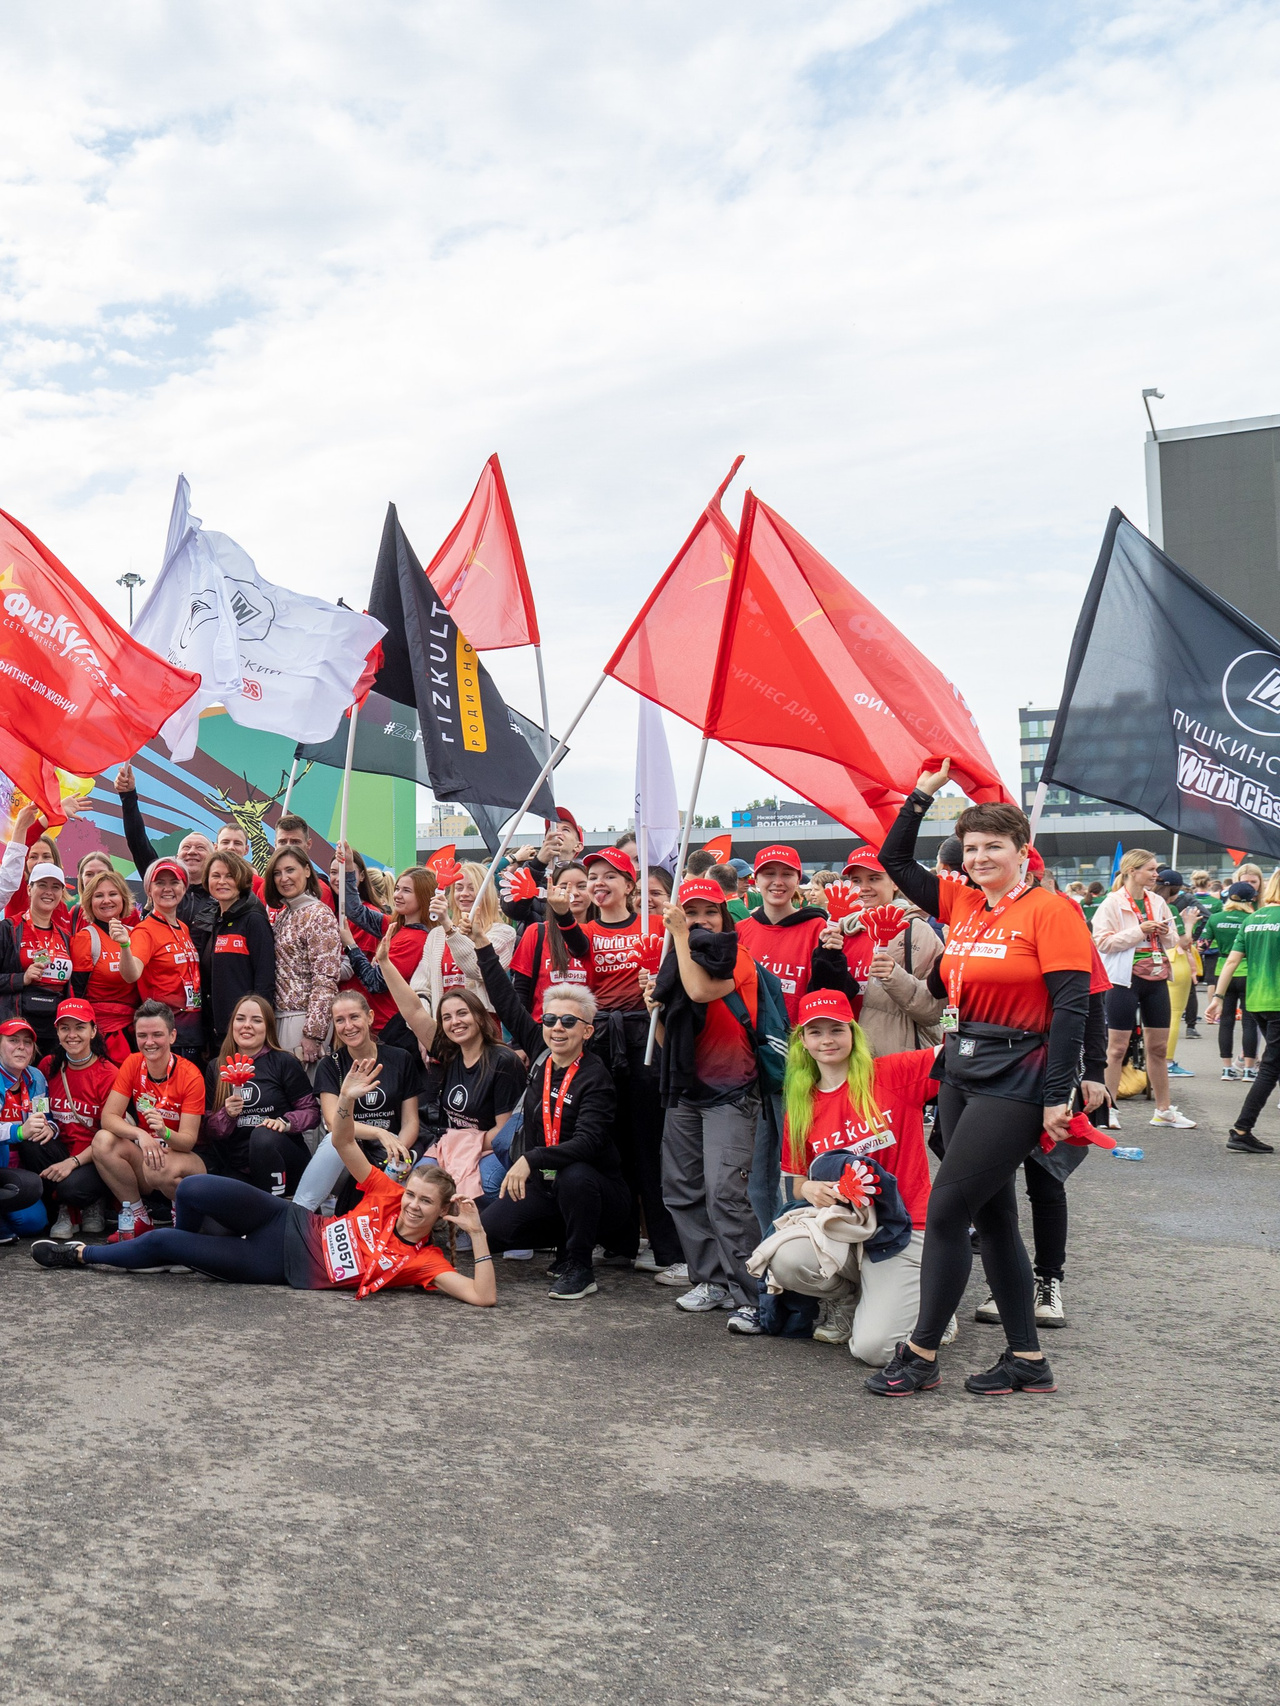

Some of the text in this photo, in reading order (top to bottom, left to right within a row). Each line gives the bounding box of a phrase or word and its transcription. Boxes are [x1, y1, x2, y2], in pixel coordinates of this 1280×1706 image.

[30, 679, 47, 697] ДЛЯ
[44, 686, 79, 716] ЖИЗНИ!
[1177, 750, 1241, 803] World
[593, 936, 624, 950] World
[595, 962, 638, 972] OUTDOOR
[805, 998, 838, 1011] FIZKULT
[354, 1110, 395, 1119] УШКИНСКИЙ
[812, 1109, 893, 1154] FIZKULT
[333, 1223, 355, 1270] 08057
